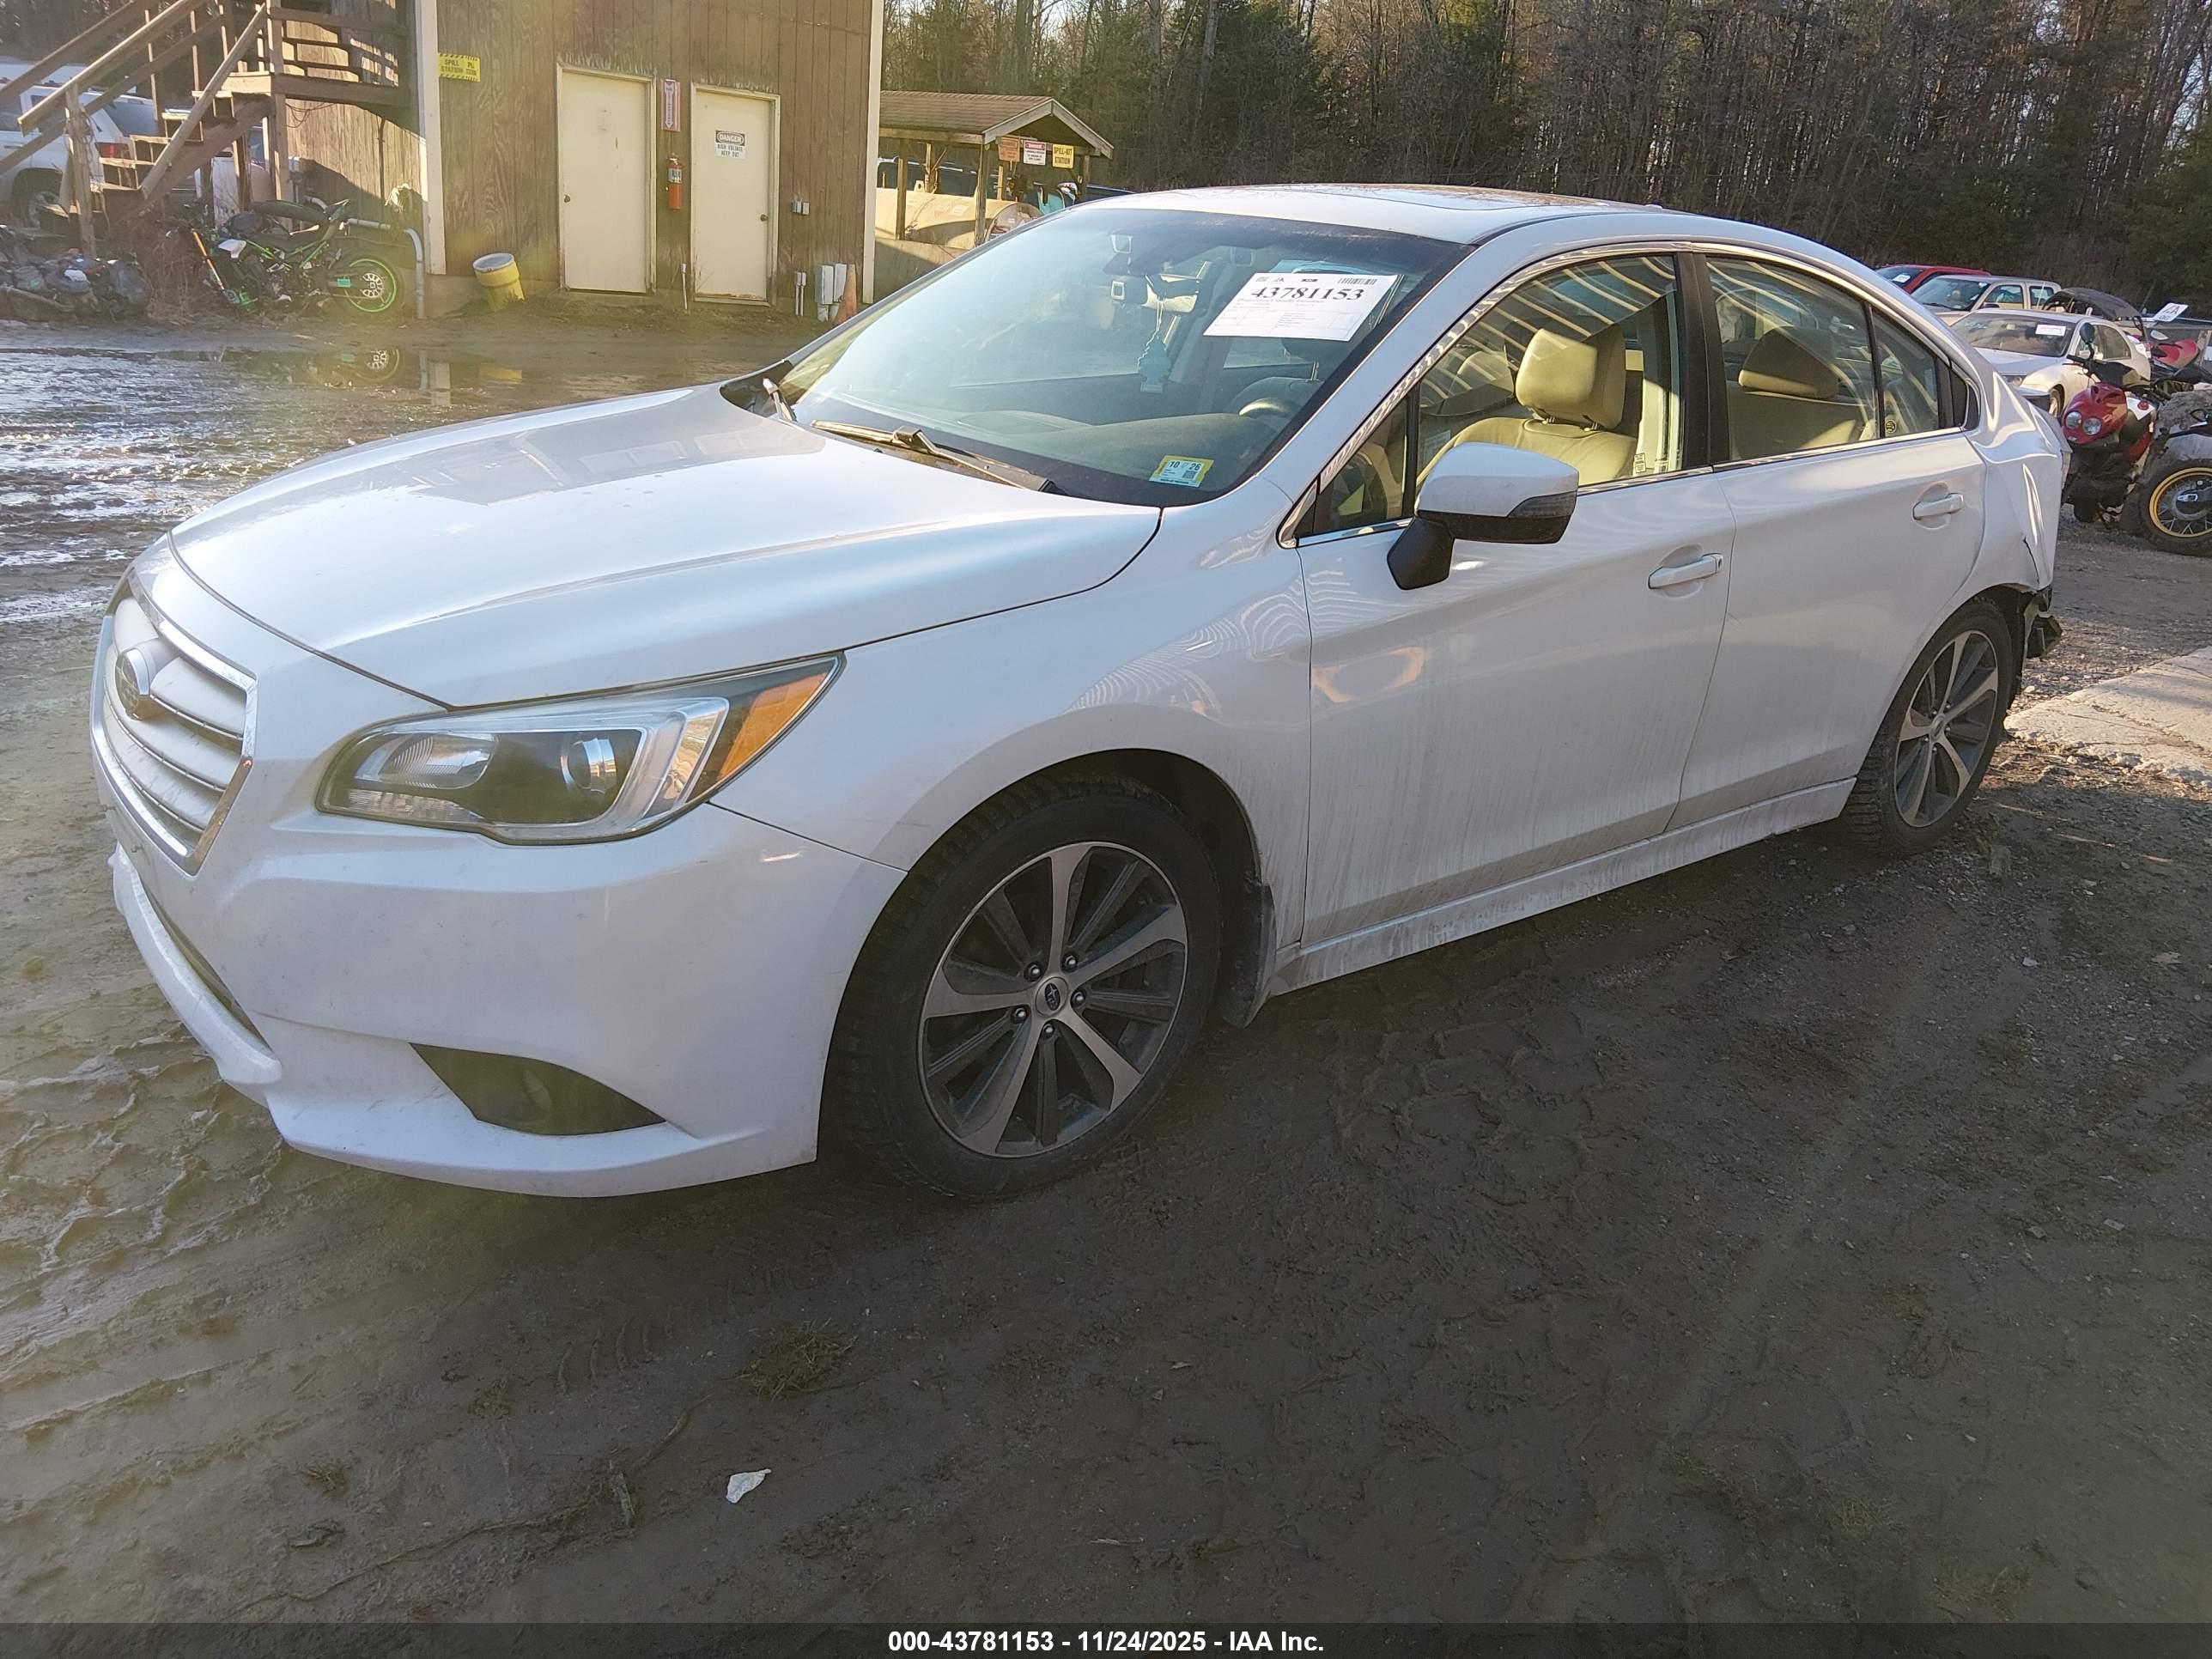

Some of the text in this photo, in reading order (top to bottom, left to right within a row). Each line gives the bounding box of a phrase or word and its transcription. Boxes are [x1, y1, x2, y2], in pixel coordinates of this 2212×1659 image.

[719, 133, 742, 143] DANGER
[1251, 286, 1364, 301] 43781153
[1169, 460, 1201, 471] 10 26
